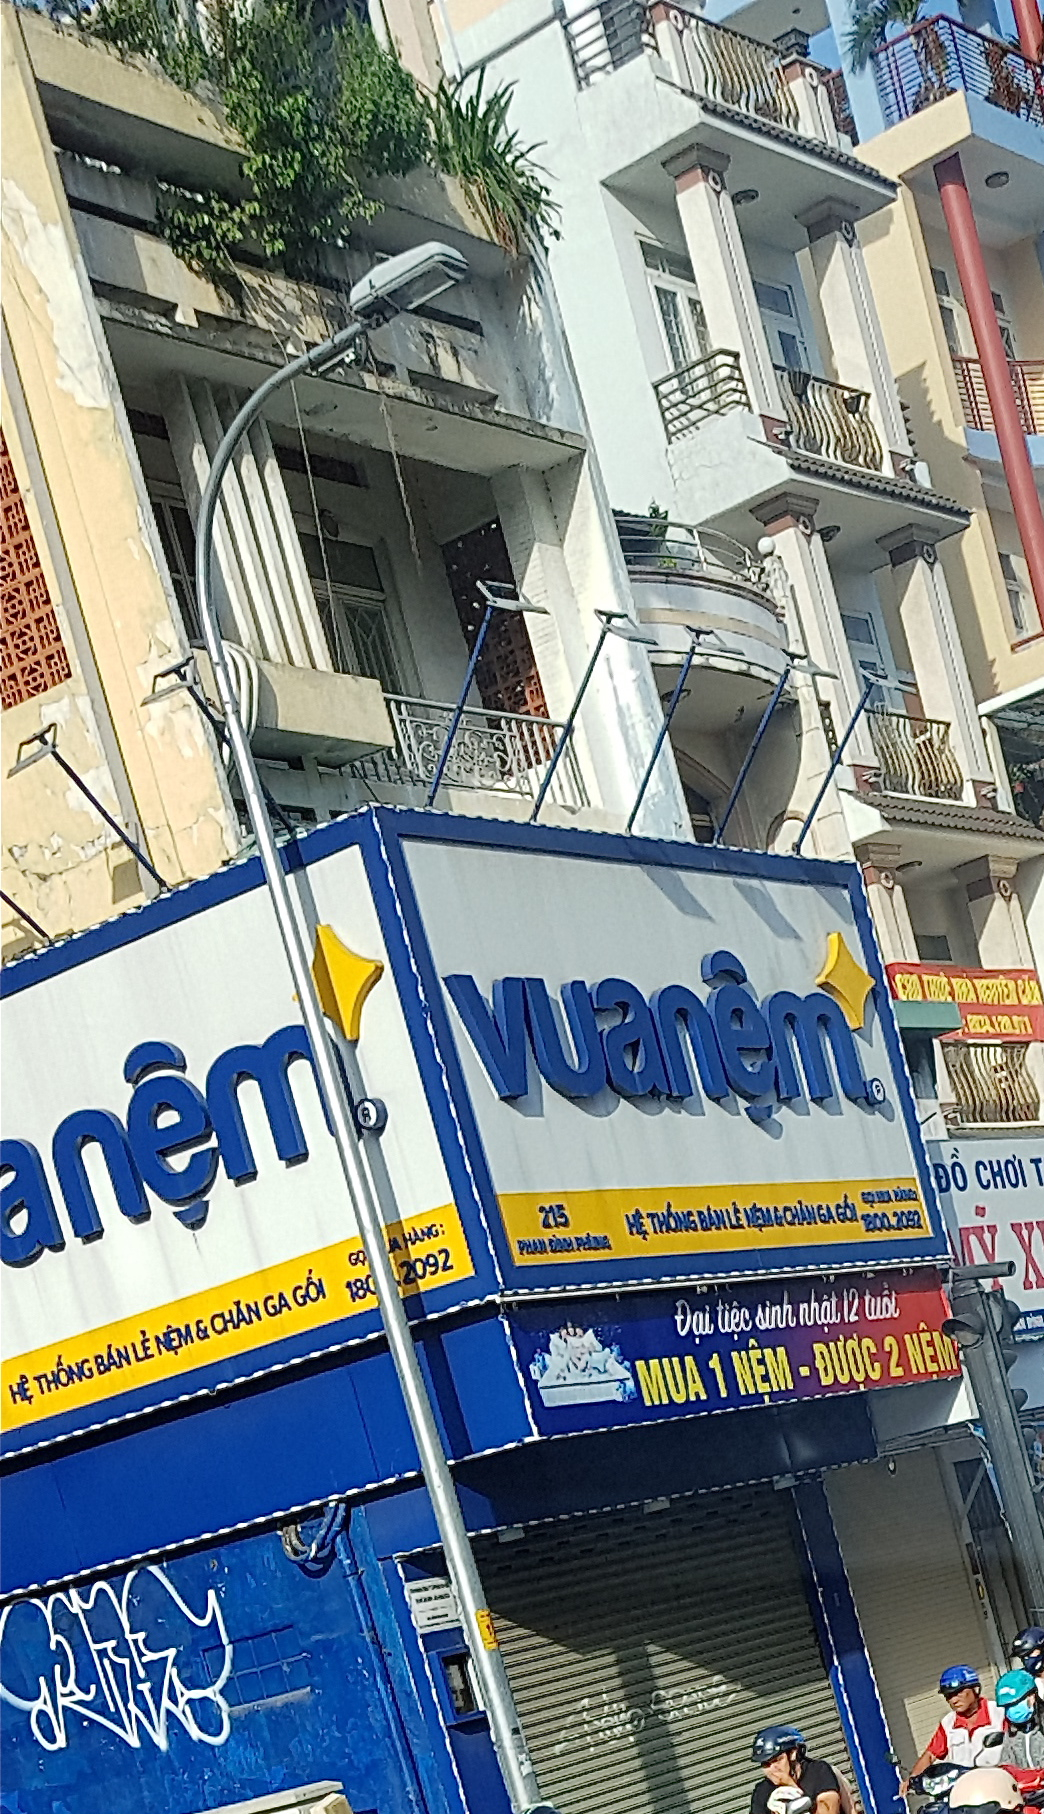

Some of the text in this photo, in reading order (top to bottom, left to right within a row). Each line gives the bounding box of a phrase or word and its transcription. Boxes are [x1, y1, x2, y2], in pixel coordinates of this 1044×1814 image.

[442, 949, 868, 1124] vuanệm
[932, 1147, 968, 1193] ĐỒ
[975, 1154, 1028, 1191] CHƠI
[625, 1208, 649, 1241] HỆ
[647, 1202, 698, 1235] THỐNG
[697, 1205, 727, 1231] BÁN
[744, 1202, 774, 1232] NỆM
[348, 1250, 367, 1267] GỌ
[9, 1269, 327, 1405] HỆ THỐNG BÁN LẺ NỆM & CHĂN GA GỐI
[675, 1299, 714, 1344] Đại
[717, 1299, 752, 1341] tiệc
[755, 1291, 797, 1330] sinh
[799, 1289, 841, 1333] nhật
[843, 1288, 860, 1324] 12
[634, 1354, 708, 1407] MUA
[708, 1352, 728, 1398] 1
[730, 1338, 794, 1405] NỆM
[813, 1332, 882, 1391] ĐƯỢC
[884, 1334, 904, 1378] 2
[903, 1321, 959, 1379] NỆM
